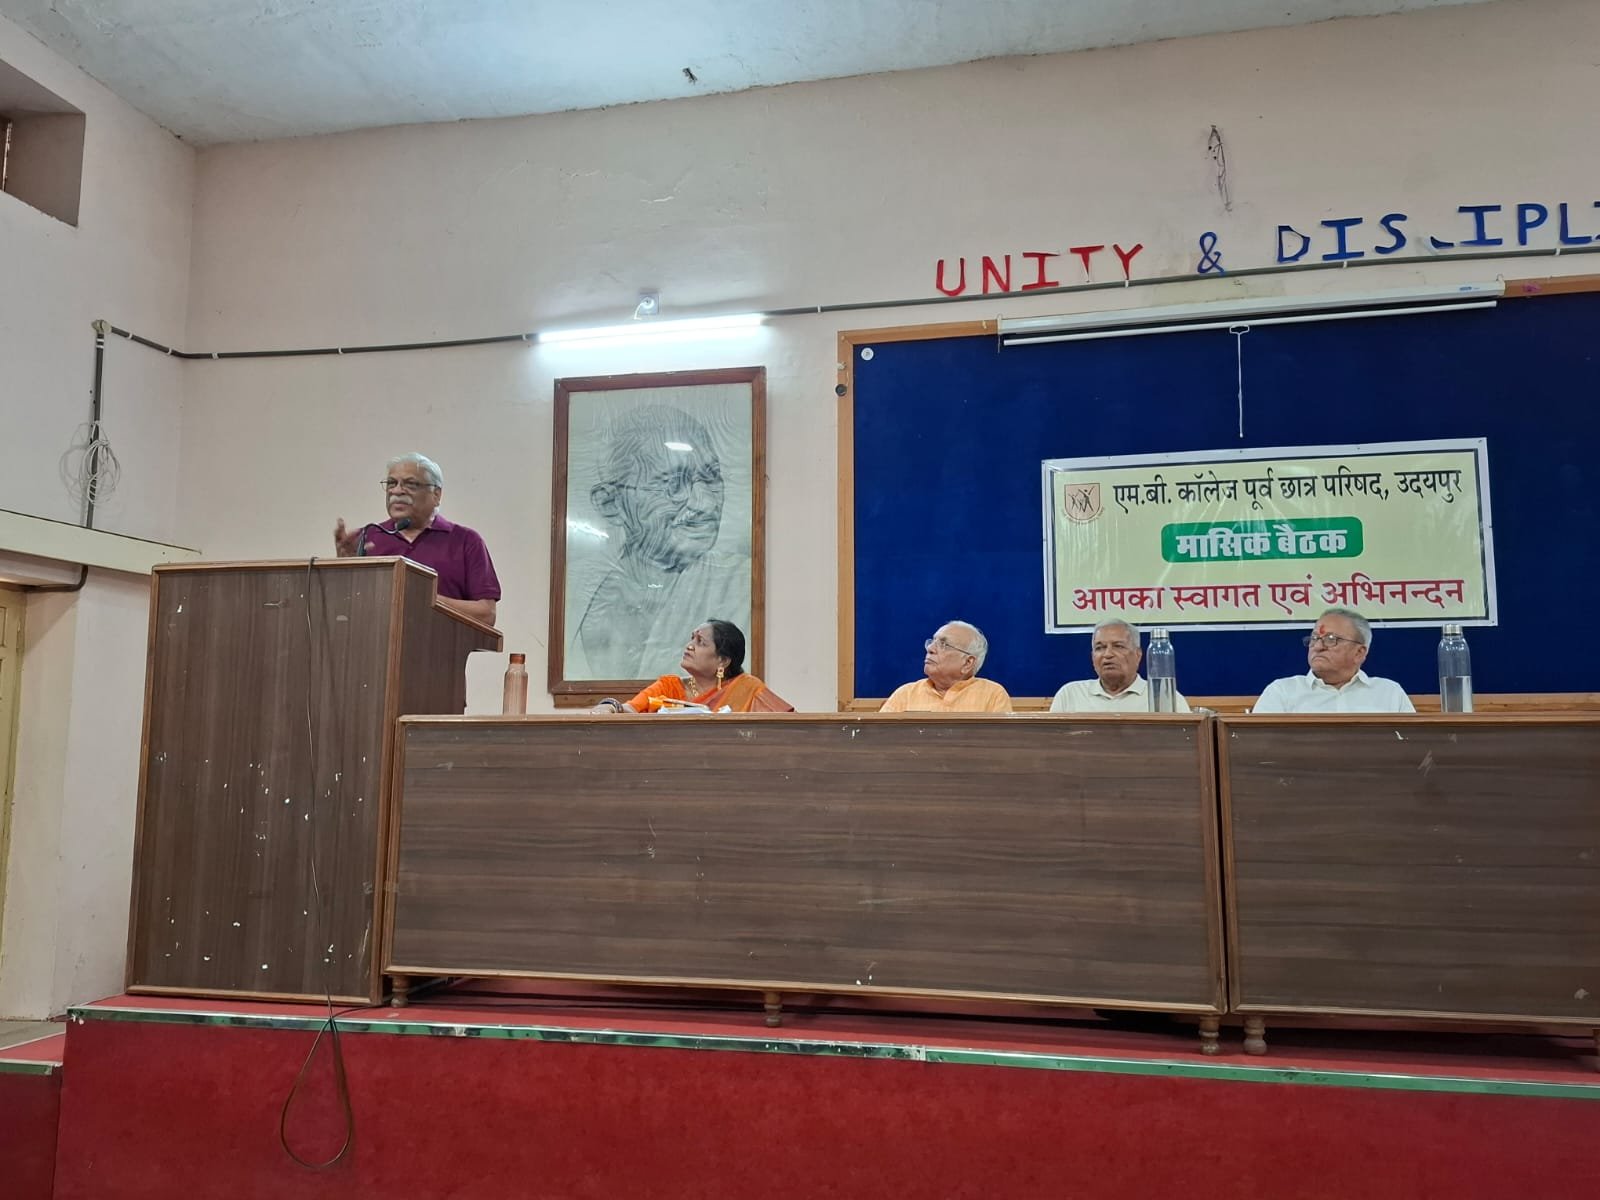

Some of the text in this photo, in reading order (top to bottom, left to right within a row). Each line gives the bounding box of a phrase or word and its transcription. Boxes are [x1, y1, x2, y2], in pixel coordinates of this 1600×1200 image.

[936, 243, 1143, 297] UNITY
[1197, 231, 1225, 275] &
[1113, 465, 1462, 513] एम.बी. कॉलेज पूर्व छात्र परिषद, उदयपुर
[1176, 523, 1347, 558] मासिक बैठक
[1072, 572, 1465, 616] आपका स्वागत एवं अभिनन्दन
